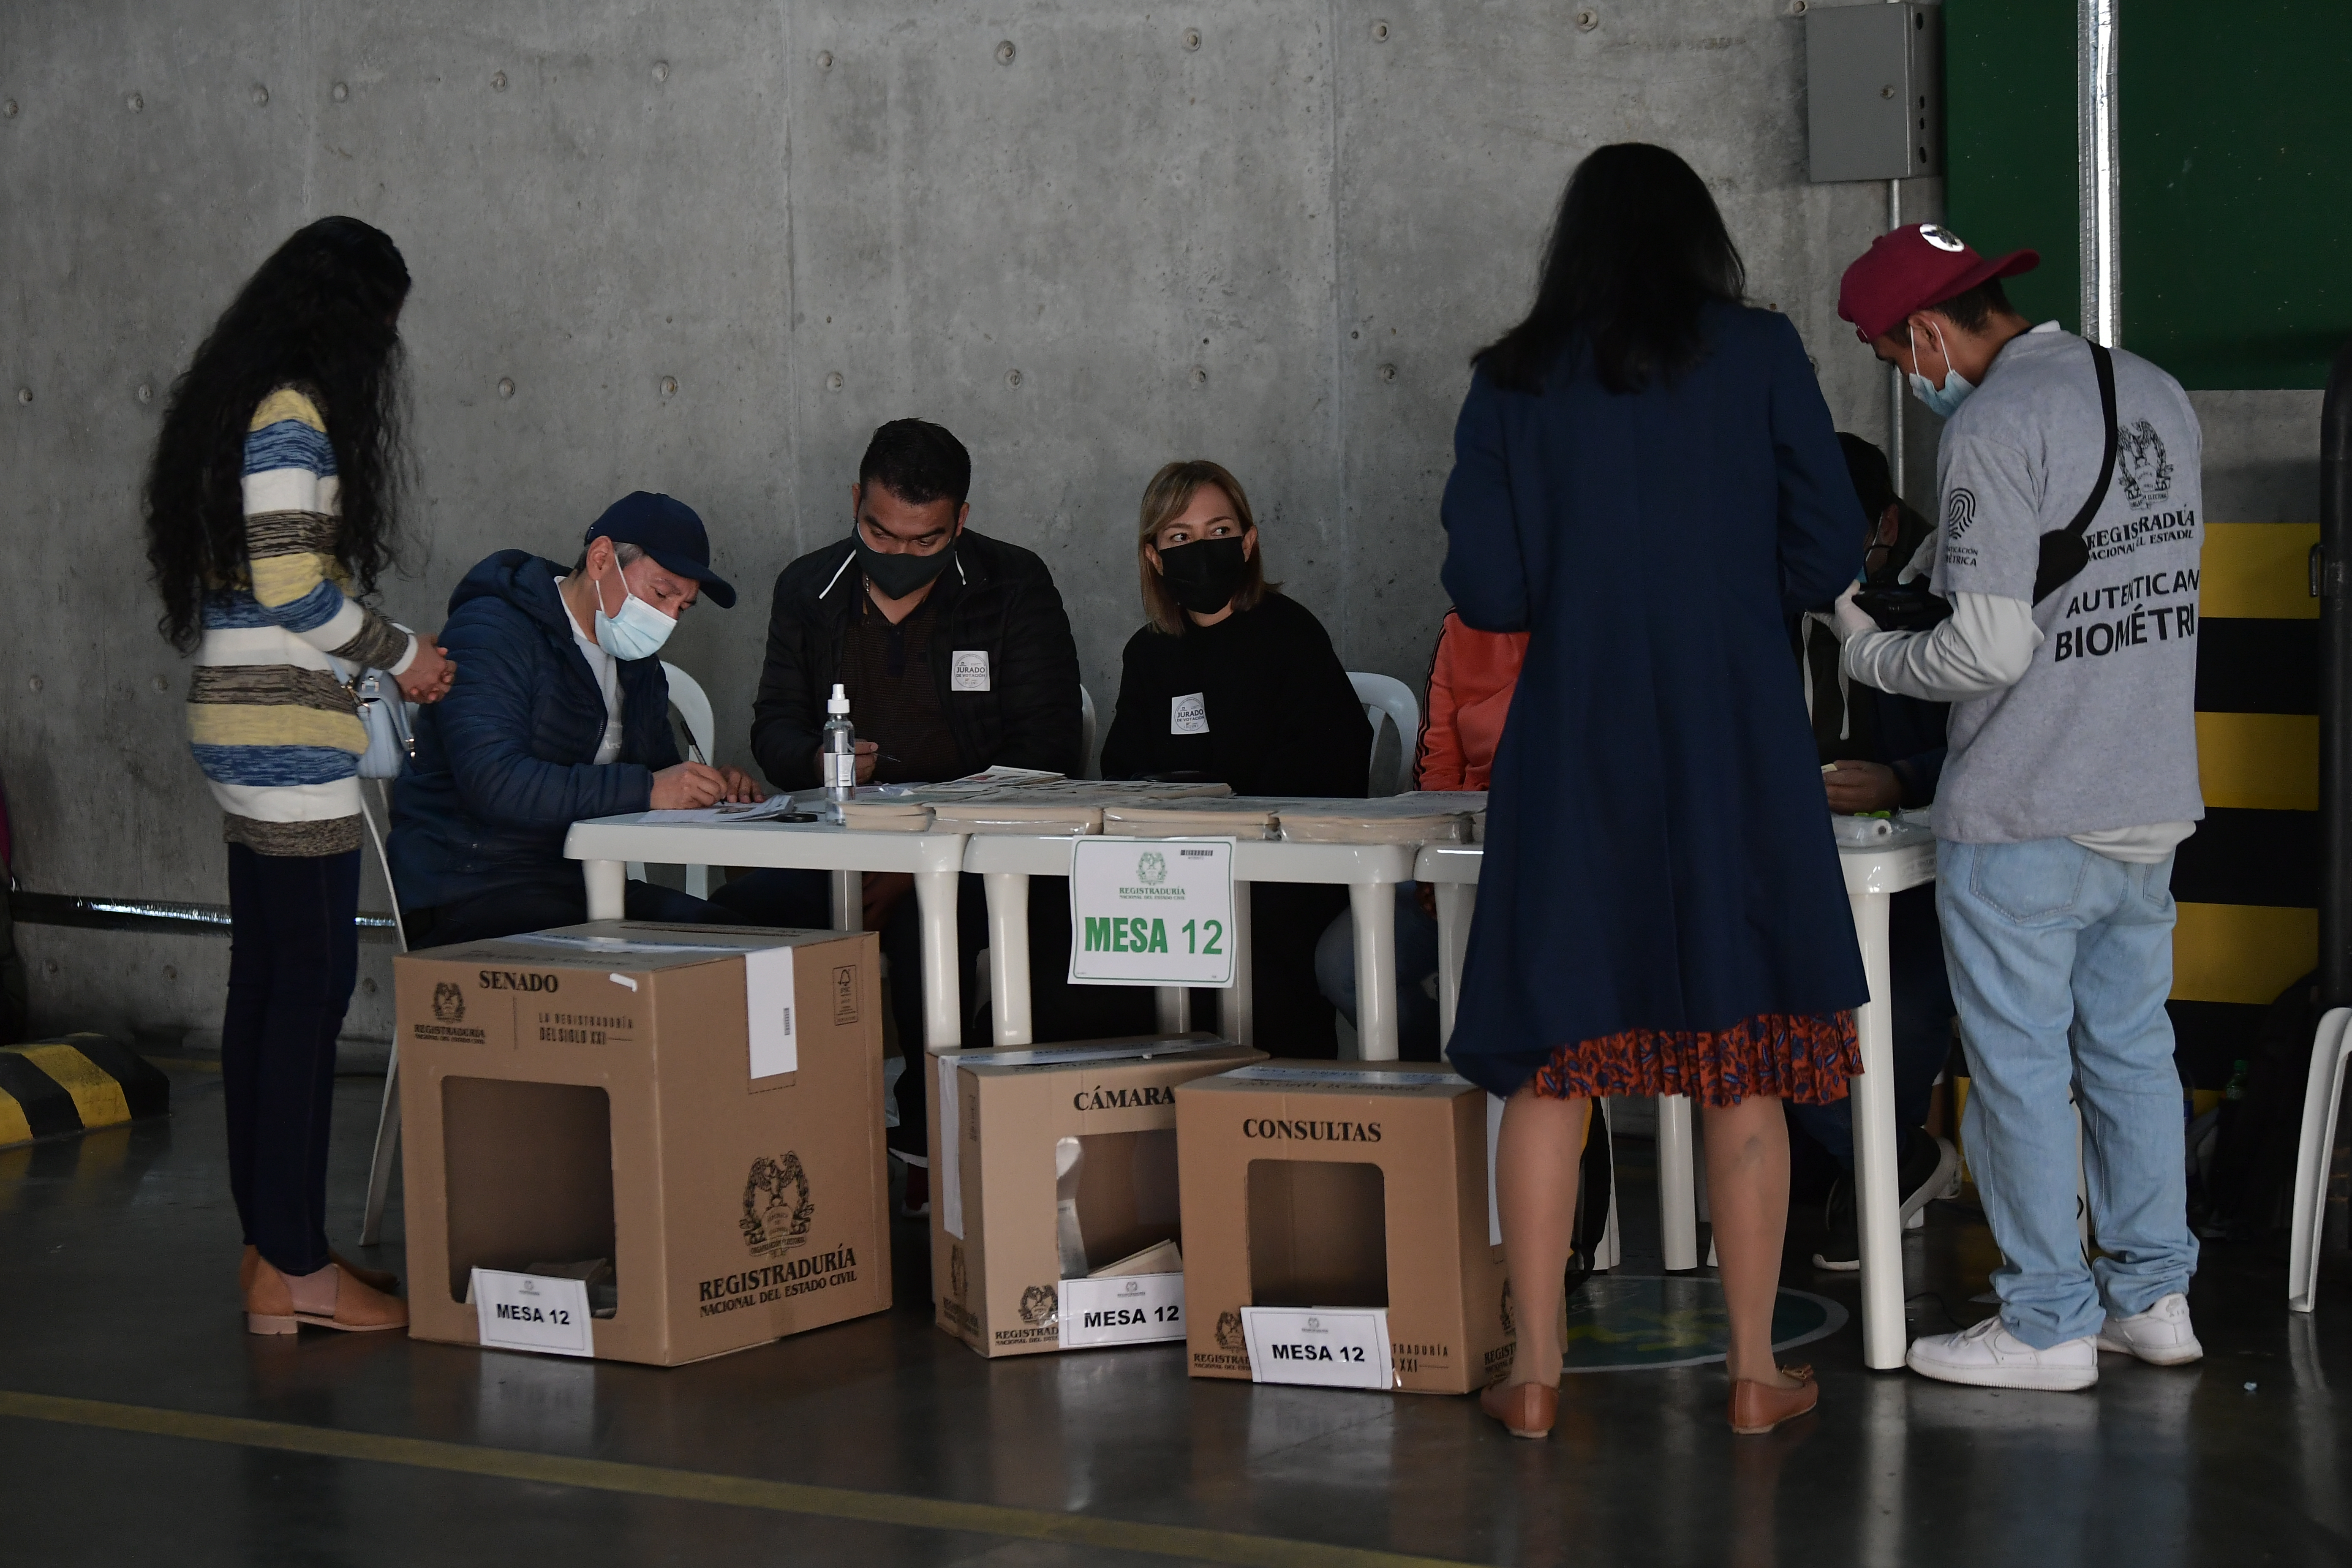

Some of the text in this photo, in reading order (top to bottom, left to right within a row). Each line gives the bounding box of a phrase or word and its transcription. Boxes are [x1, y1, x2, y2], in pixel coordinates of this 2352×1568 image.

[1177, 709, 1203, 718] JURADO
[1119, 886, 1185, 895] REGISTRADURÍA
[1084, 917, 1222, 955] MESA 12
[479, 970, 558, 993] SENADO
[540, 1027, 606, 1045] DEL SIGLO XXI
[1073, 1085, 1176, 1111] CÁMARA
[1243, 1119, 1381, 1142] CONSULTAS
[699, 1243, 856, 1302] REGISTRADURÍA
[700, 1270, 857, 1318] NACIONAL DEL ESTADO CIVIL
[497, 1304, 570, 1325] MESA 12
[1084, 1305, 1179, 1328] MESA 12
[995, 1327, 1059, 1339] REGISTRAD
[1271, 1345, 1365, 1362] MESA 12
[1400, 1358, 1417, 1372] XXI
